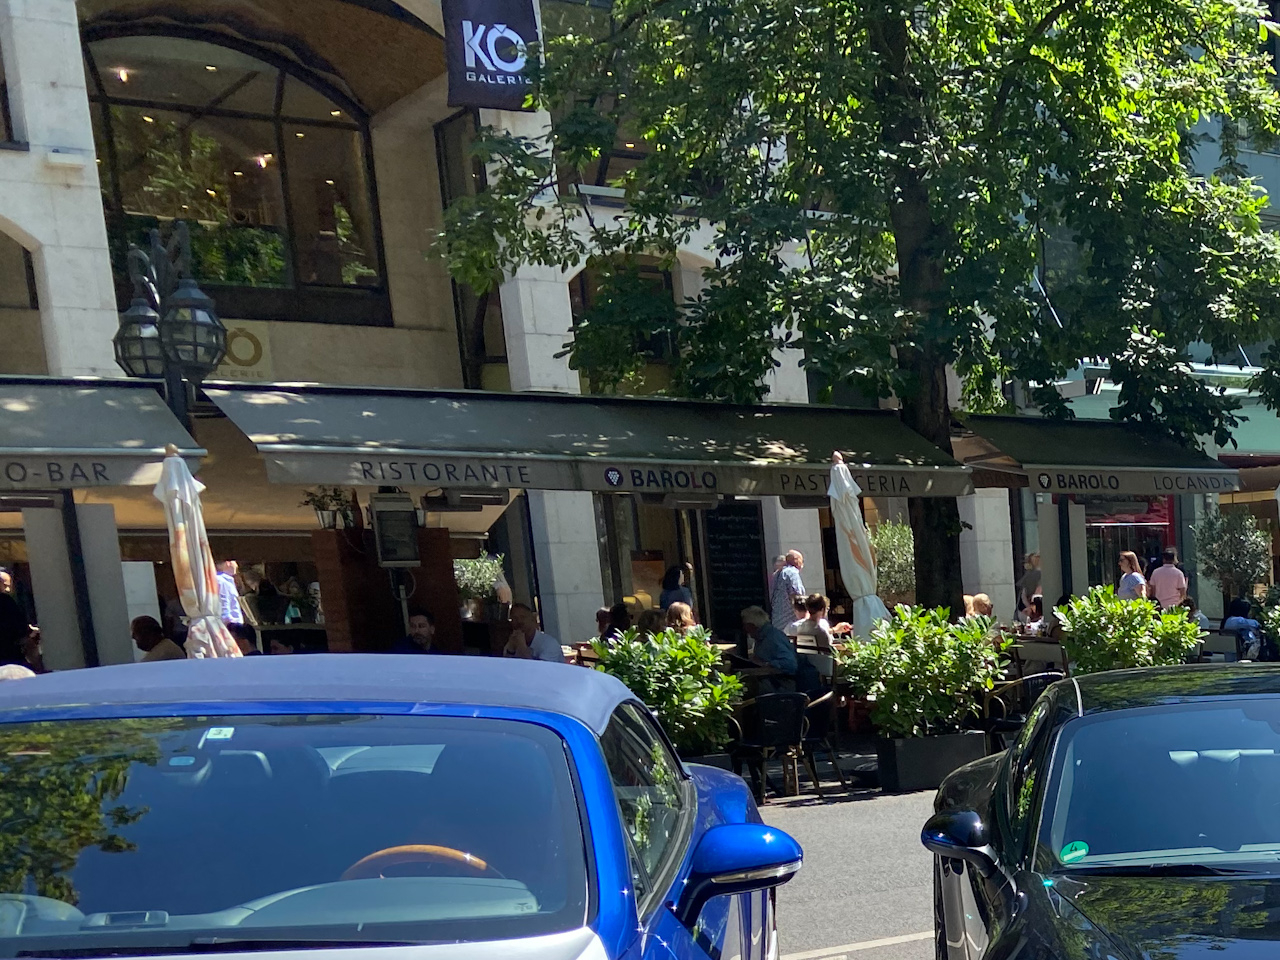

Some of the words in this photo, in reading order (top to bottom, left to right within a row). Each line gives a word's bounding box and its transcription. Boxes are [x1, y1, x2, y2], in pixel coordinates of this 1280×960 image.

[360, 461, 530, 484] RISTORANTE
[630, 469, 717, 488] BAROLO
[1057, 474, 1120, 490] BAROLO
[1153, 475, 1234, 490] LOCANDA
[780, 473, 911, 493] PASTCERIA
